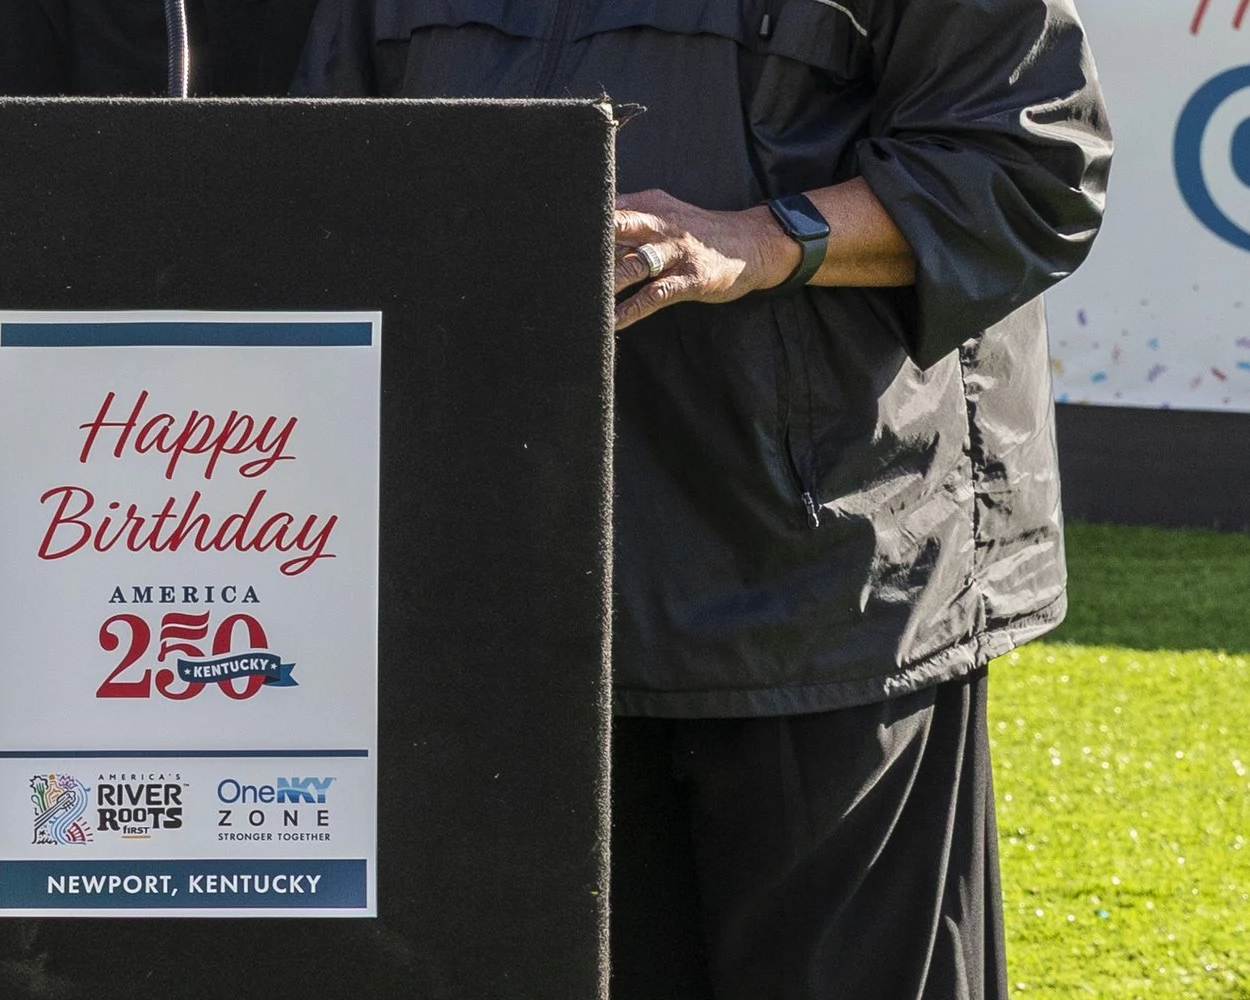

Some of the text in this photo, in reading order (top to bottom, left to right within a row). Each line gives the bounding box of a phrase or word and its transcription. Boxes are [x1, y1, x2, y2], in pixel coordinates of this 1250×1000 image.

[79, 390, 298, 480] Happy
[37, 486, 338, 576] Birthday
[108, 585, 260, 604] AMERICA
[96, 609, 269, 700] 250
[193, 658, 270, 678] KENTUCKY
[98, 784, 182, 806] RIVER
[97, 807, 182, 831] ROOTS
[218, 809, 329, 826] ZONE
[218, 832, 331, 841] STRONGER TOGETHER
[48, 874, 321, 896] NEWPORT, KENTUCKY
